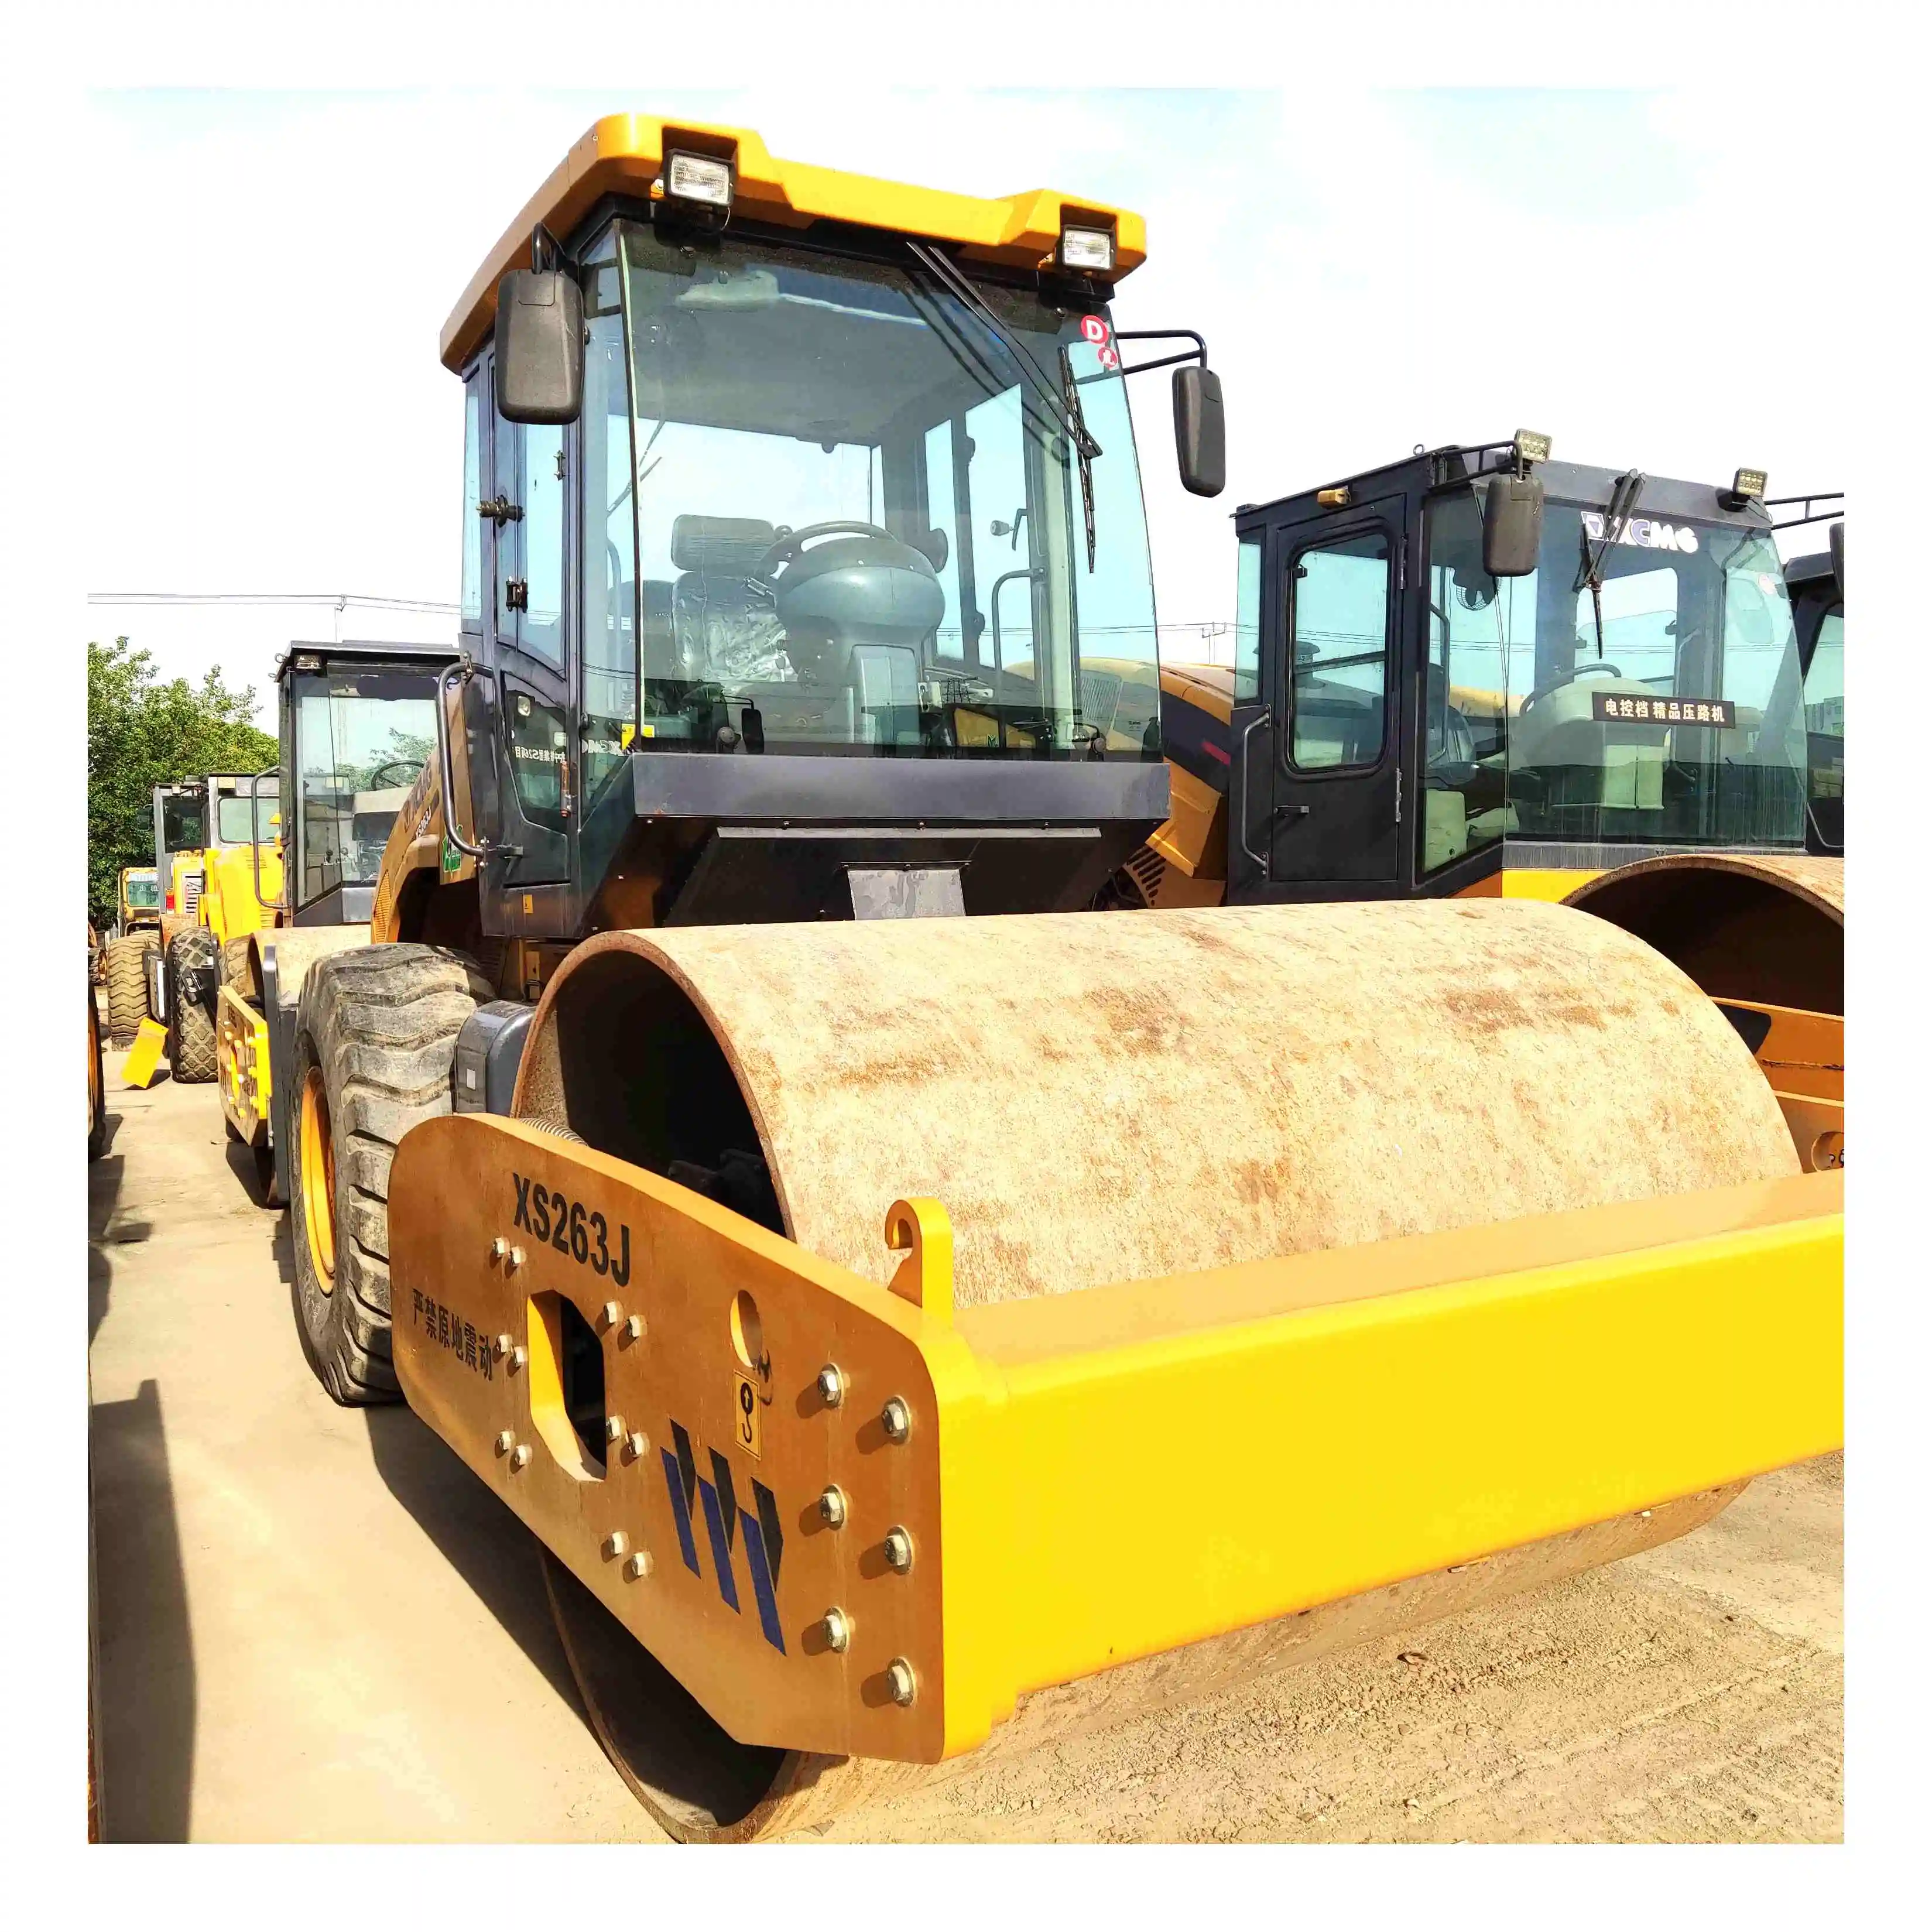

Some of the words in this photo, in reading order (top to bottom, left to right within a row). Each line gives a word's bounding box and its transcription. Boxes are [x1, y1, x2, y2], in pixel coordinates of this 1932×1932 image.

[1605, 698, 1649, 718] 电控档
[1653, 701, 1725, 722] 精品压路机
[513, 1172, 630, 1287] XS263J
[412, 1287, 492, 1381] 严禁原地震动
